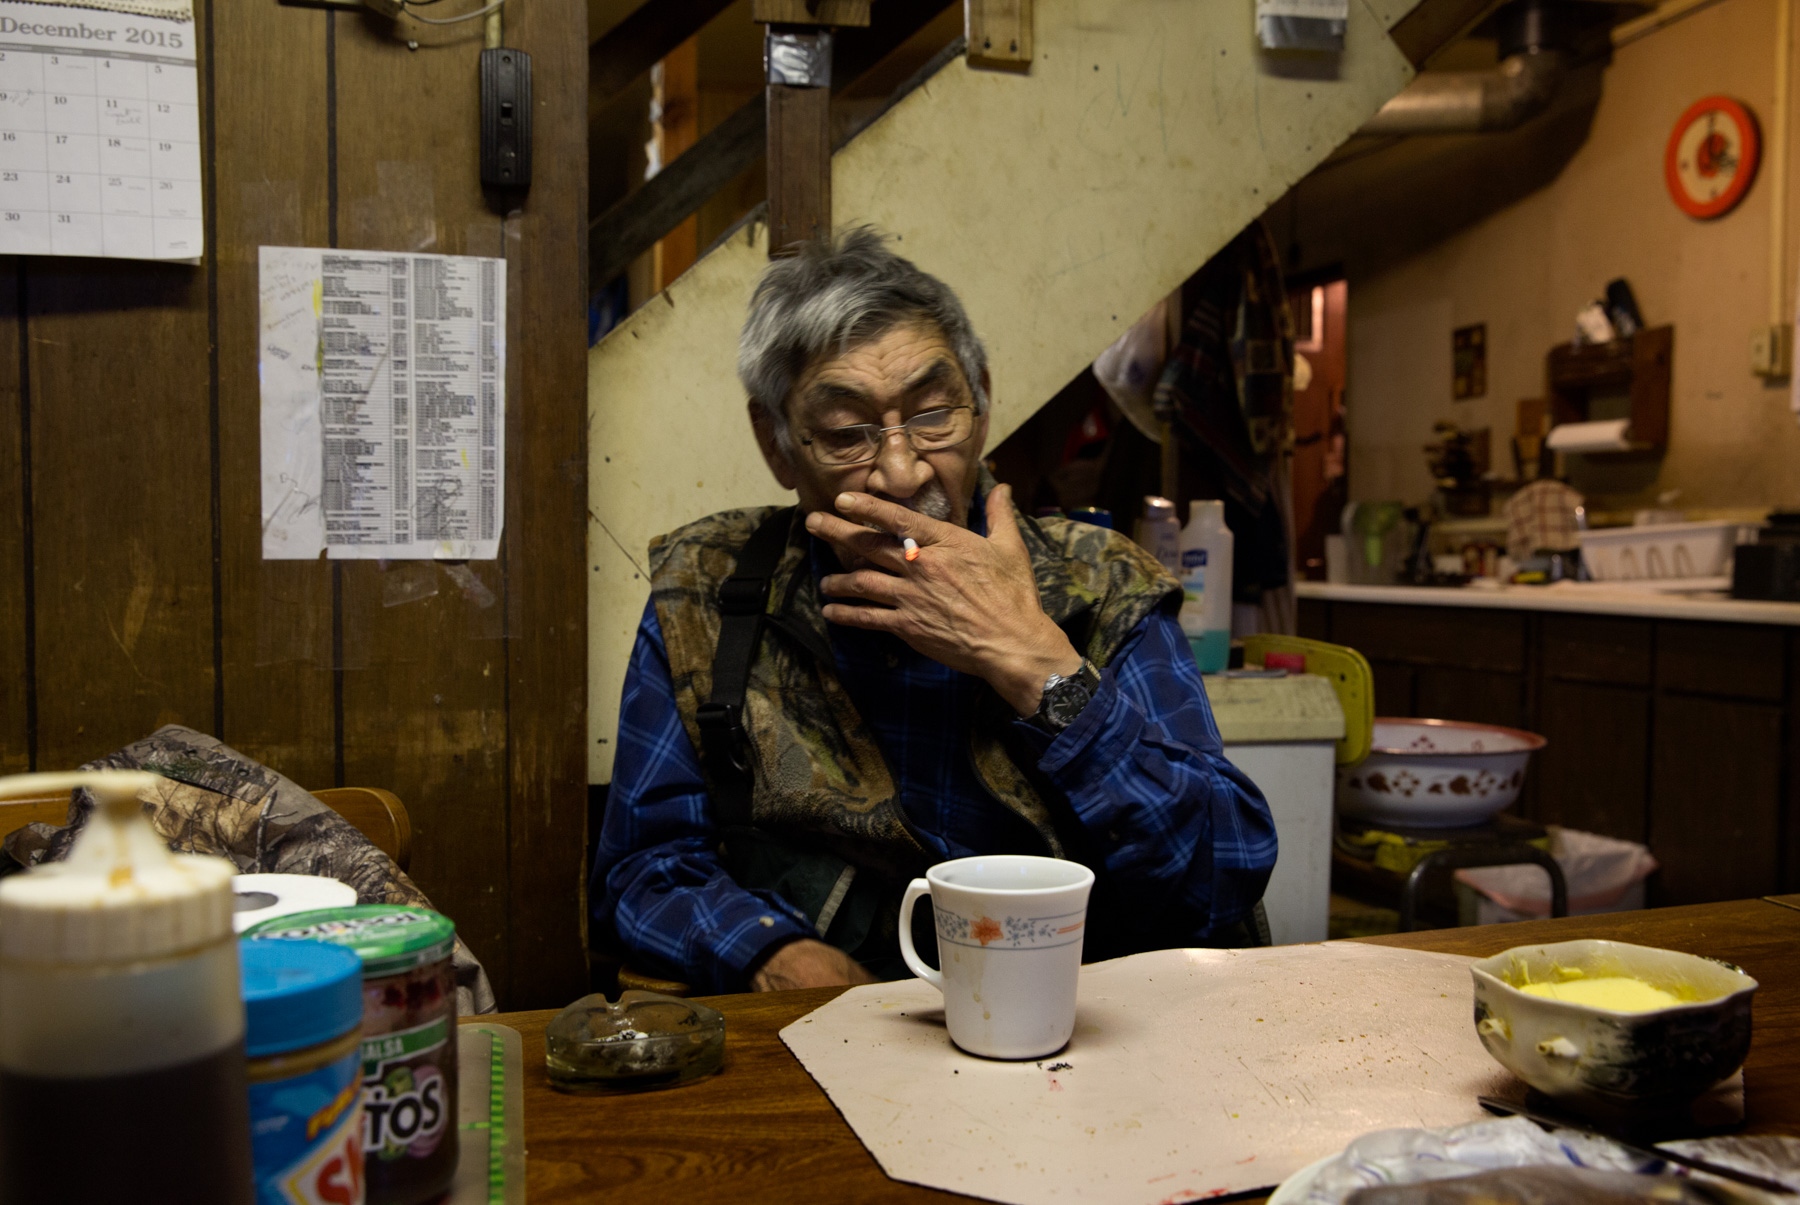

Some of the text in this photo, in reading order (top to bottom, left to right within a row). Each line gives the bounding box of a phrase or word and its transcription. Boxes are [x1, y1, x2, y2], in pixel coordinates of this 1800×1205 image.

[0, 17, 183, 49] December 2015
[51, 56, 58, 65] 3
[104, 60, 111, 69] 4
[155, 65, 162, 74] 5
[54, 96, 67, 105] 10
[106, 99, 118, 108] 11
[157, 104, 170, 113] 12
[2, 132, 172, 151] 16 17 18 19
[3, 172, 173, 190] 23 24 25 26
[5, 212, 71, 223] 30 31
